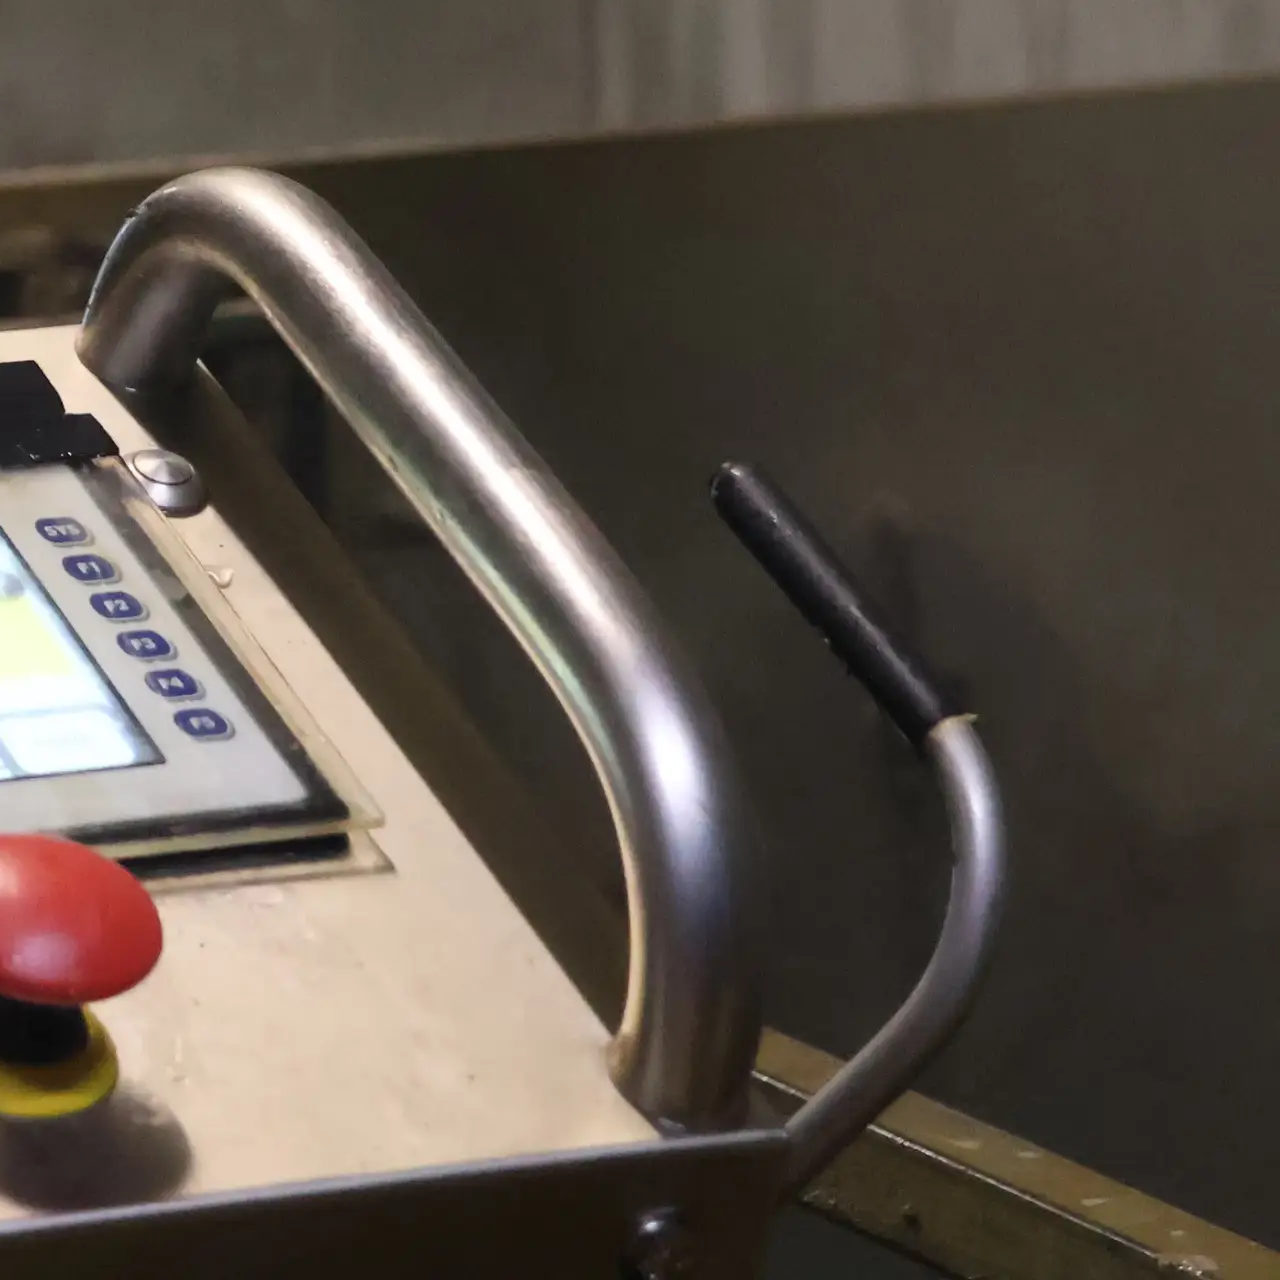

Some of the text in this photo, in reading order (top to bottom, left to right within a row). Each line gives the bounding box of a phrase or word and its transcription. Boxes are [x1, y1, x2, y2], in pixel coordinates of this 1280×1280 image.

[76, 561, 101, 574] F1
[103, 599, 130, 614] F2
[130, 637, 157, 651] F3
